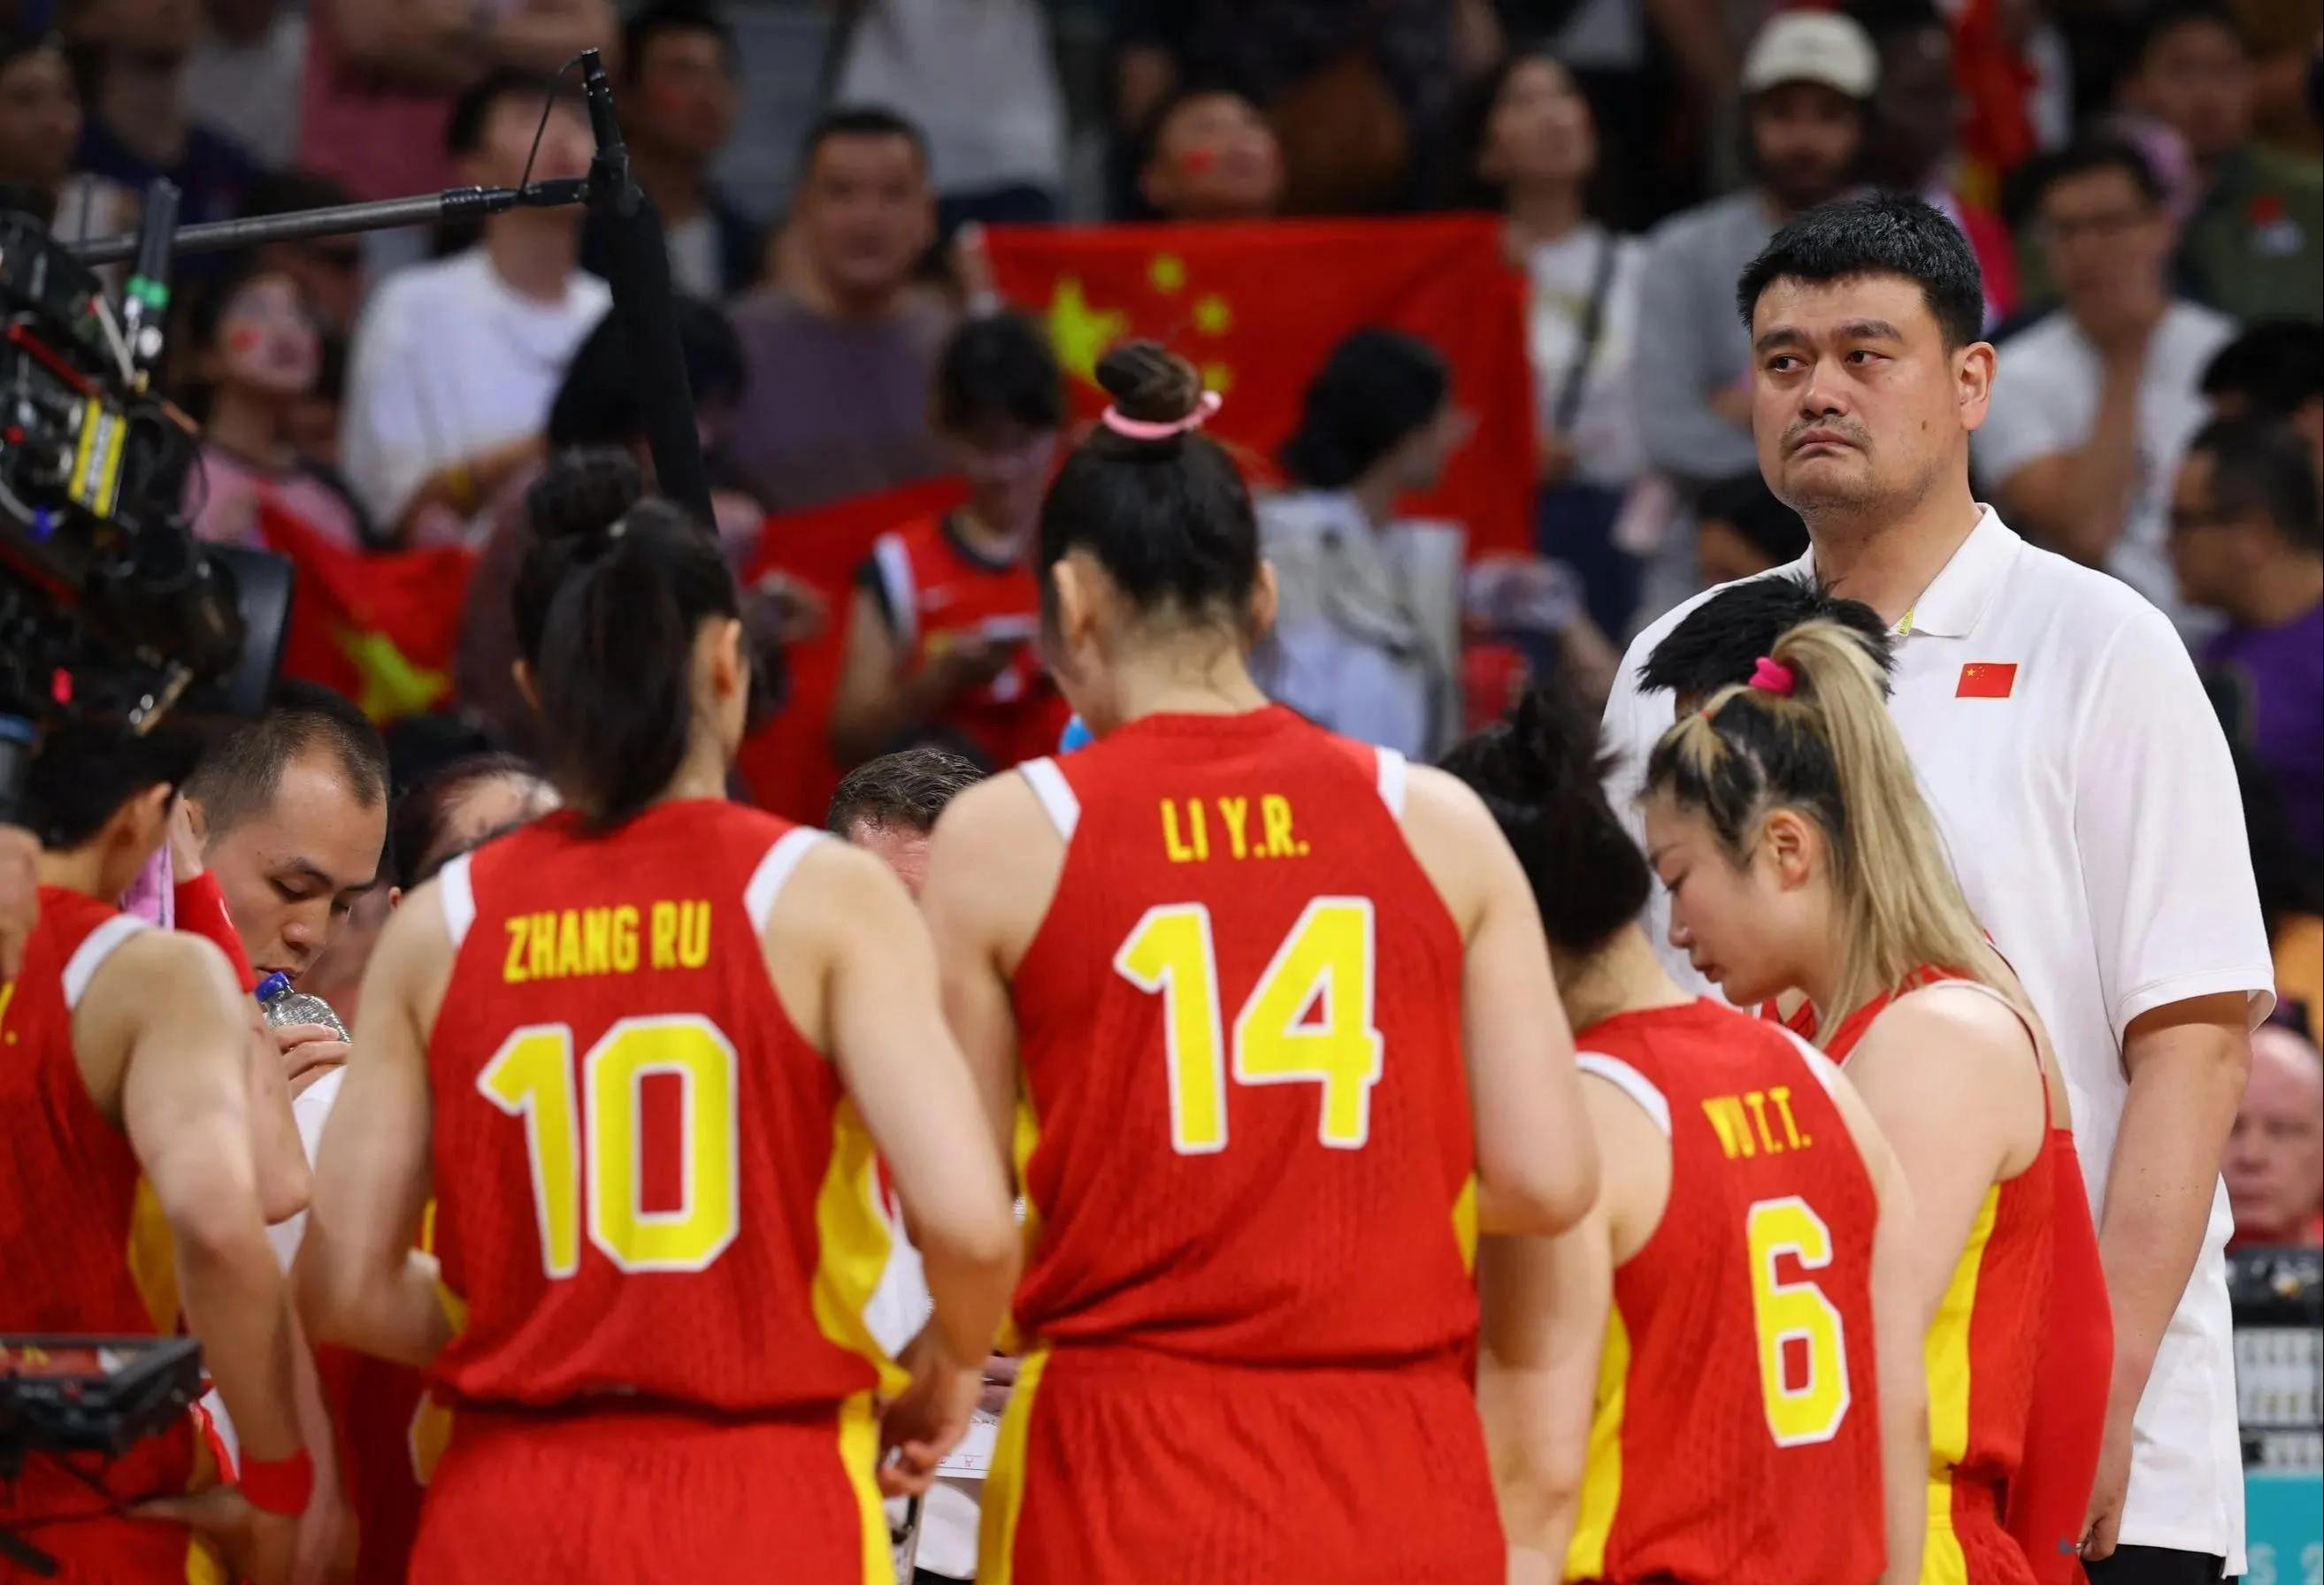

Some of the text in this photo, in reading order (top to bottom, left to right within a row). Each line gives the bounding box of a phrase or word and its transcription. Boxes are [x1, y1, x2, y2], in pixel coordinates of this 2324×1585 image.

[502, 899, 712, 984] ZHANG RU
[1160, 793, 1310, 863] LI Y.R.
[476, 1013, 740, 1279] 10
[1113, 895, 1384, 1155] 14
[1745, 1194, 1852, 1449] 6
